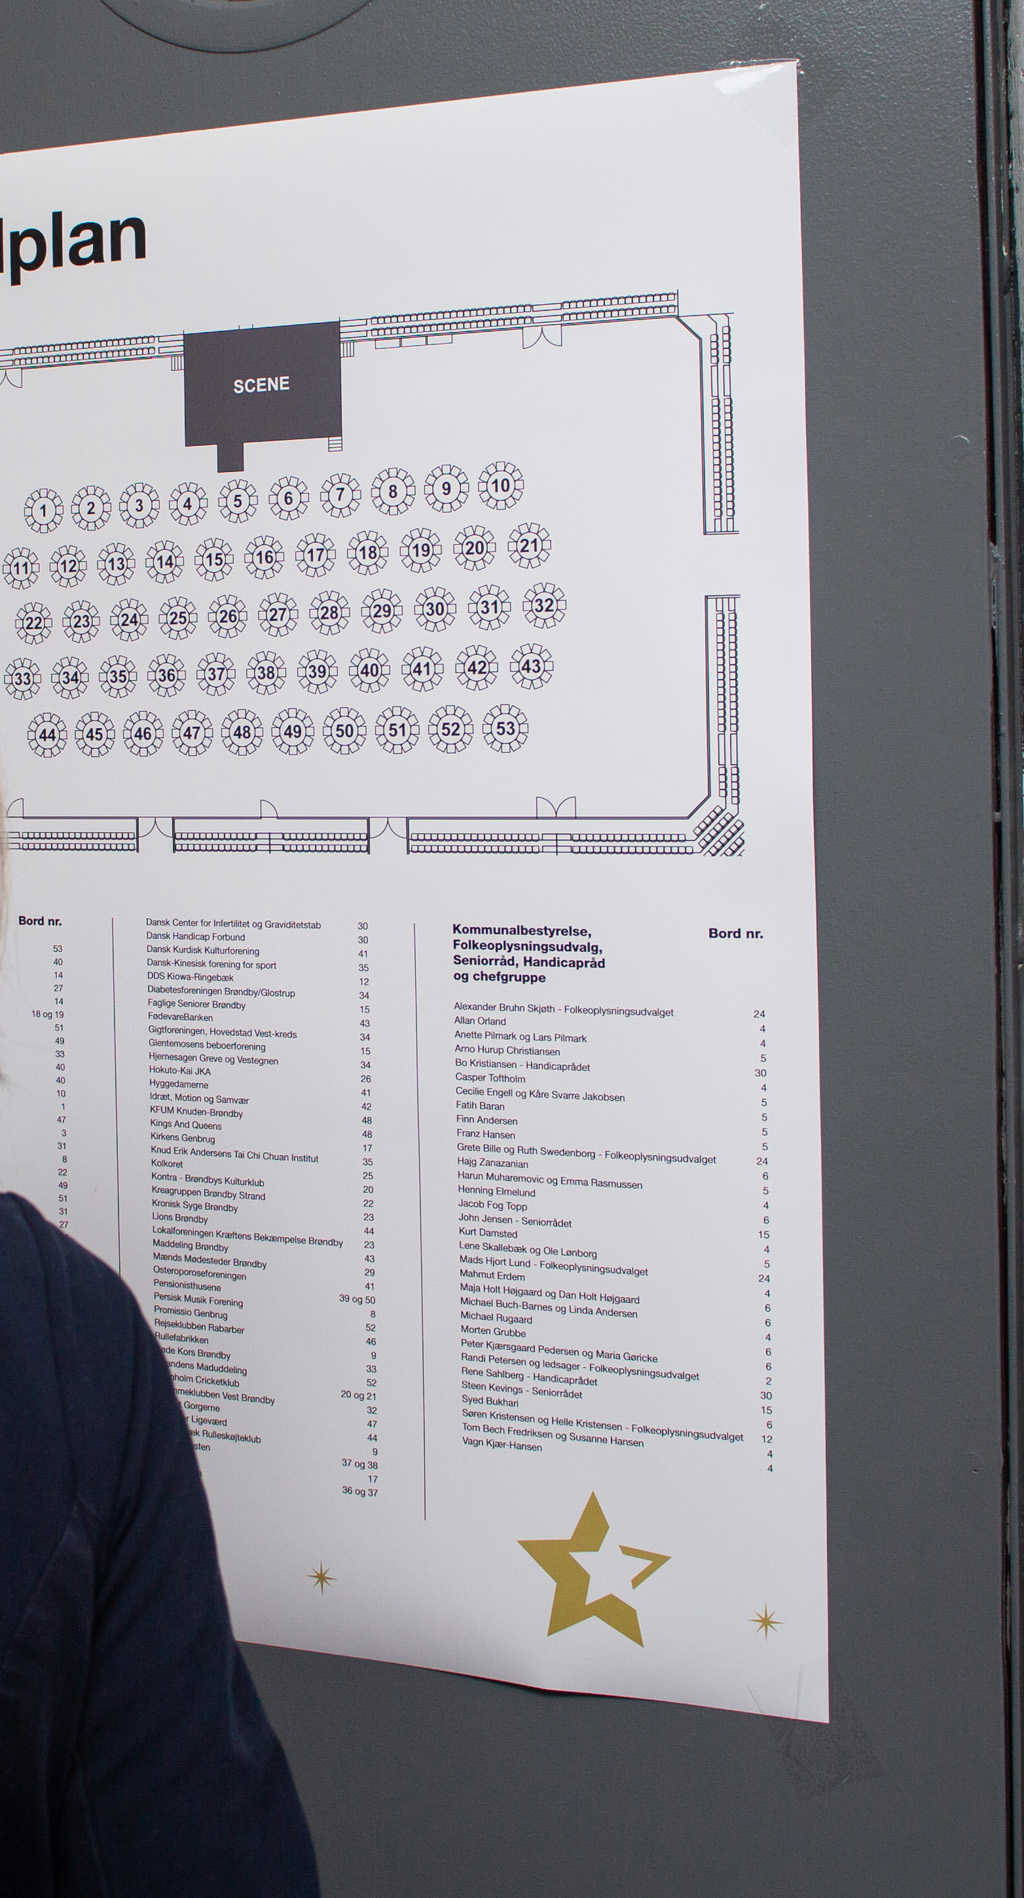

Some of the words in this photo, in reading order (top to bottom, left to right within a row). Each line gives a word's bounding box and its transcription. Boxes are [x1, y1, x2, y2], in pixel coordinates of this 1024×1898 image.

[233, 375, 290, 394] SCENE
[39, 504, 46, 517] 1
[87, 501, 96, 515] 2
[135, 498, 144, 512] 3
[183, 496, 192, 510] 4
[233, 494, 242, 508] 5
[284, 491, 293, 505] 6
[336, 487, 345, 501] 7
[388, 484, 398, 499] 8
[441, 481, 451, 496] 9
[491, 478, 510, 493] 10
[13, 561, 28, 575] 11
[60, 559, 77, 573] 12
[108, 557, 125, 571] 13
[156, 554, 174, 569] 14
[206, 552, 223, 567] 15
[256, 550, 274, 564] 16
[307, 548, 325, 562] 17
[359, 545, 377, 560] 18
[412, 543, 430, 557] 19
[465, 540, 484, 556] 20
[520, 538, 537, 553] 21
[25, 616, 42, 630] 22
[73, 614, 90, 628] 23
[121, 613, 138, 627] 24
[169, 611, 187, 625] 25
[219, 609, 237, 623] 26
[269, 607, 287, 622] 27
[320, 605, 339, 620] 28
[373, 603, 391, 618] 29
[426, 601, 445, 616] 30
[481, 599, 498, 615] 31
[534, 597, 554, 613] 32
[14, 672, 31, 686] 33
[62, 670, 79, 685] 34
[109, 669, 127, 683] 35
[158, 668, 176, 682] 36
[207, 667, 226, 681] 37
[257, 665, 275, 680] 38
[308, 664, 327, 679] 39
[360, 663, 379, 678] 40
[412, 661, 430, 676] 41
[467, 660, 487, 675] 42
[521, 658, 541, 673] 43
[39, 728, 56, 742] 44
[85, 727, 103, 741] 45
[134, 726, 152, 741] 46
[183, 726, 201, 740] 47
[233, 725, 251, 739] 48
[283, 724, 302, 739] 49
[335, 723, 354, 738] 50
[388, 723, 405, 737] 51
[441, 721, 460, 737] 52
[496, 721, 515, 736] 53
[18, 915, 45, 926] Bord
[47, 918, 62, 926] nr.
[145, 917, 171, 926] Dansk
[172, 918, 199, 927] Center
[200, 918, 211, 927] for
[213, 919, 250, 928] Infertilitet
[251, 921, 263, 930] og
[264, 919, 322, 929] Graviditetstab
[357, 921, 369, 931] 30
[452, 923, 592, 939] Kommunalbestyrelse,
[708, 927, 741, 939] Bord
[745, 930, 764, 939] nr.
[52, 944, 63, 953] 53
[146, 944, 171, 954] Dansk
[172, 944, 203, 954] Kurdisk
[204, 945, 260, 958] Kulturforening
[453, 938, 603, 955] Folkeoplysningsudvalg,
[358, 949, 368, 958] 41
[53, 957, 64, 966] 40
[453, 954, 519, 968] Seniorråd,
[523, 955, 606, 970] Handicapråd
[453, 972, 469, 983] og
[472, 970, 546, 985] chefgruppe
[53, 984, 63, 992] 27
[147, 984, 223, 997] Diabetesforeningen
[223, 986, 296, 999] Brøndby/Glostrup
[359, 991, 370, 1000] 34
[31, 1009, 41, 1018] 18
[42, 1011, 53, 1020] og
[54, 1010, 65, 1019] 19
[753, 1009, 766, 1019] 24
[453, 1015, 476, 1025] Allan
[477, 1016, 507, 1026] Orland
[209, 1027, 253, 1037] Hovedstad
[253, 1028, 298, 1039] Vest-kreds
[454, 1029, 483, 1039] Anette
[484, 1030, 517, 1040] Pilmark
[518, 1033, 531, 1043] og
[532, 1032, 552, 1042] Lars
[554, 1033, 587, 1043] Pilmark
[55, 1050, 65, 1058] 33
[454, 1044, 476, 1053] Arno
[477, 1044, 505, 1056] Hurup
[506, 1045, 561, 1056] Christiansen
[194, 1067, 212, 1076] JKA
[754, 1068, 767, 1078] 30
[149, 1078, 209, 1089] Hyggedamerne
[173, 1119, 190, 1129] And
[191, 1120, 222, 1131] Queens
[456, 1114, 475, 1123] Finn
[476, 1115, 518, 1126] Andersen
[363, 1143, 373, 1152] 17
[479, 1157, 529, 1169] Zanazanian
[756, 1156, 768, 1166] 24
[57, 1167, 68, 1176] 22
[362, 1171, 374, 1180] 25
[151, 1184, 202, 1198] Kreagruppen
[203, 1188, 237, 1201] Brøndby
[238, 1190, 266, 1201] Strand
[457, 1184, 494, 1197] Henning
[495, 1186, 536, 1198] Elmelund
[151, 1211, 174, 1221] Lions
[174, 1213, 209, 1226] Brøndby
[758, 1230, 770, 1240] 15
[758, 1274, 770, 1283] 24
[153, 1278, 222, 1292] Pensionisthusene
[153, 1291, 182, 1302] Persisk
[183, 1294, 207, 1304] Musik
[208, 1296, 244, 1309] Forening
[460, 1296, 493, 1307] Michael
[495, 1299, 553, 1312] Buch-Barnes
[554, 1305, 567, 1315] og
[568, 1304, 594, 1315] Linda
[595, 1306, 638, 1319] Andersen
[193, 1308, 228, 1322] Genbrug
[460, 1310, 494, 1321] Michael
[495, 1312, 533, 1325] Rugaard
[460, 1324, 491, 1335] Morten
[493, 1326, 526, 1338] Grubbe
[760, 1391, 773, 1400] 30
[462, 1422, 481, 1432] Tom
[482, 1423, 506, 1434] Bech
[507, 1426, 553, 1439] Fredriksen
[555, 1432, 567, 1442] og
[569, 1431, 608, 1444] Susanne
[610, 1435, 645, 1448] Hansen
[462, 1435, 484, 1448] Vagn
[485, 1438, 543, 1452] Kjær-Hansen
